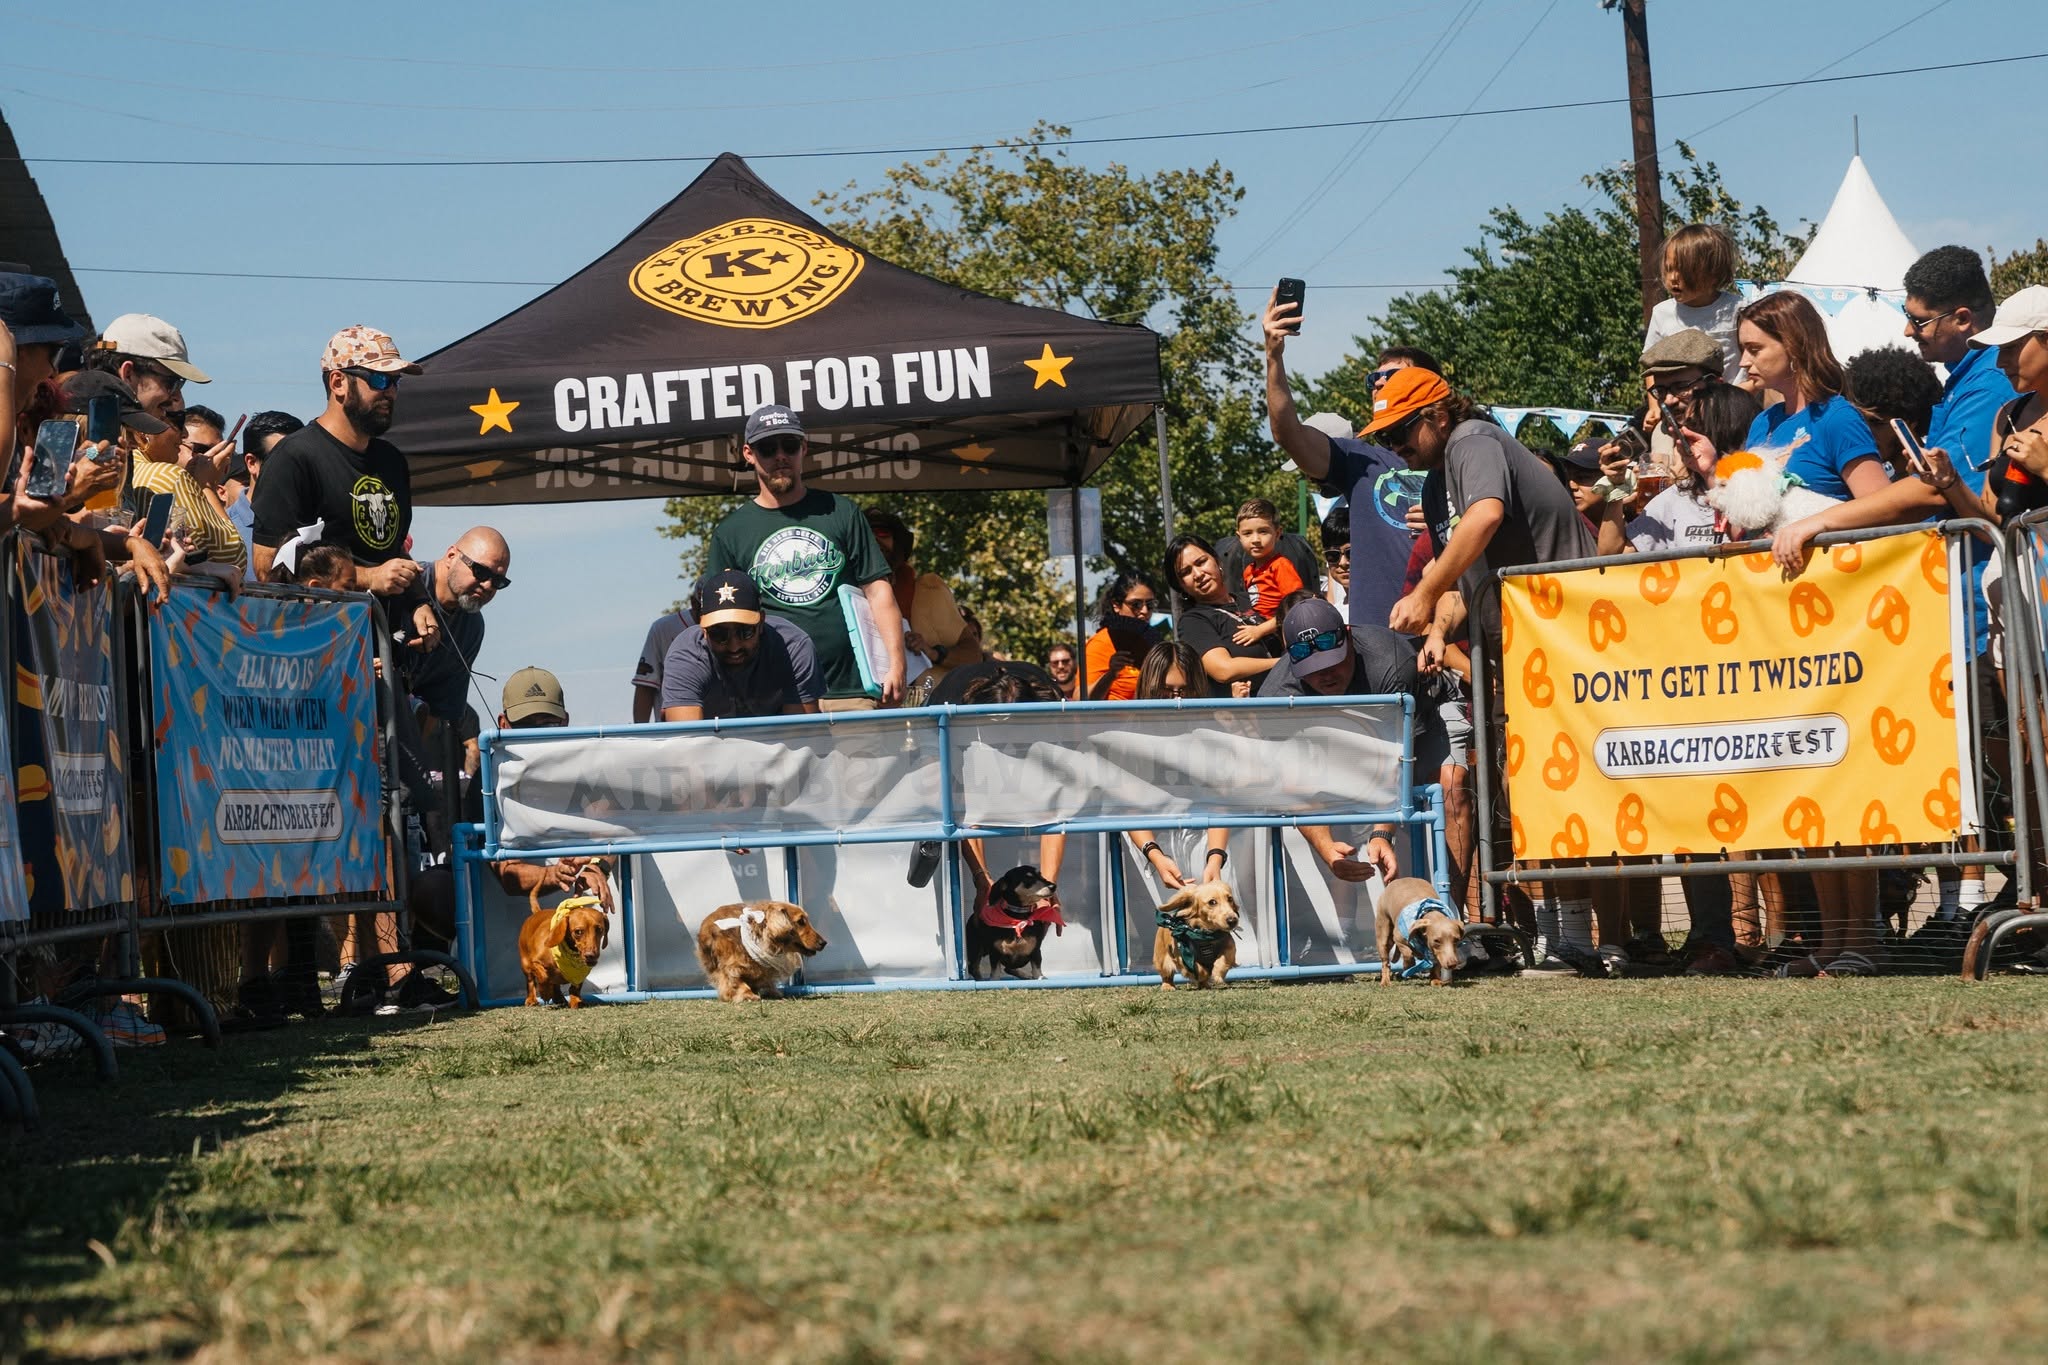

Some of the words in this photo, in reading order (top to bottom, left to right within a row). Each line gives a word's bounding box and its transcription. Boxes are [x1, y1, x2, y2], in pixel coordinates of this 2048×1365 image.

[650, 224, 837, 269] KARBACH
[702, 248, 772, 279] K
[654, 263, 842, 317] BREWING
[553, 363, 775, 433] CRAFTED
[785, 355, 884, 412] FOR
[892, 346, 992, 405] FUN
[773, 529, 793, 543] NEWS
[795, 529, 820, 542] BEERS
[748, 540, 842, 588] Karbach
[776, 592, 813, 603] SOFTBALL
[236, 655, 267, 689] ALL
[270, 656, 277, 688] I
[276, 655, 300, 690] DO
[300, 656, 314, 690] IS
[1572, 668, 1653, 704] DON'T
[1661, 664, 1709, 699] GET
[1717, 662, 1742, 695] IT
[1749, 650, 1864, 692] TWISTED
[222, 695, 256, 729] WIEN
[257, 696, 290, 730] WIEN
[294, 697, 328, 730] WIEN
[219, 736, 243, 770] NO
[243, 737, 296, 771] MATTER
[296, 738, 337, 770] WHAT
[1605, 727, 1837, 767] KARBACHTOBERFEST
[224, 802, 335, 831] KARBACHTOBERFEST
